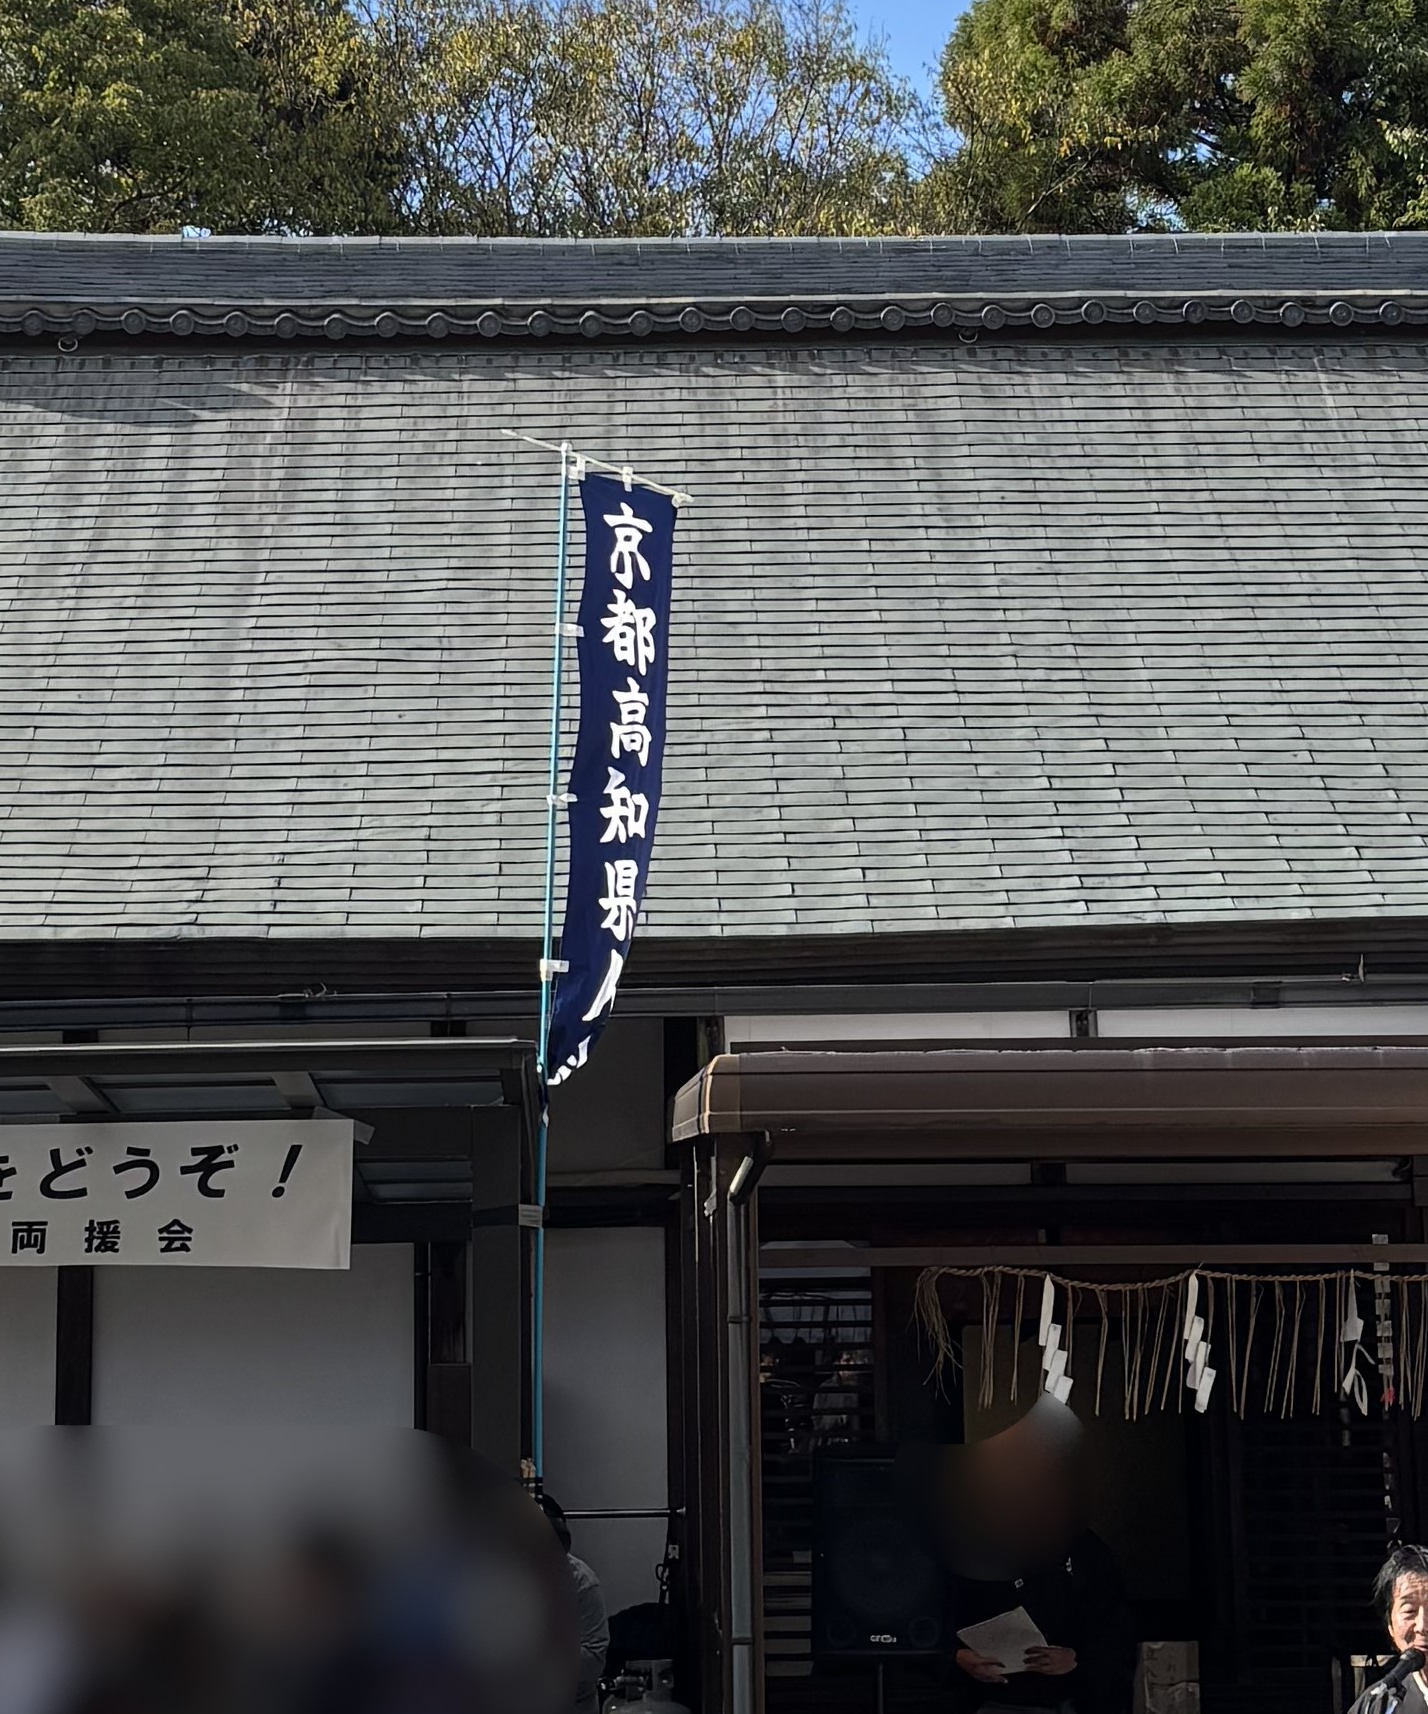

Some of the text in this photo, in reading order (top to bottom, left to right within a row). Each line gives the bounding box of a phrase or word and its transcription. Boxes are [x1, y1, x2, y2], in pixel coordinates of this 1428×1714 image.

[549, 502, 656, 1086] 京都高知県人
